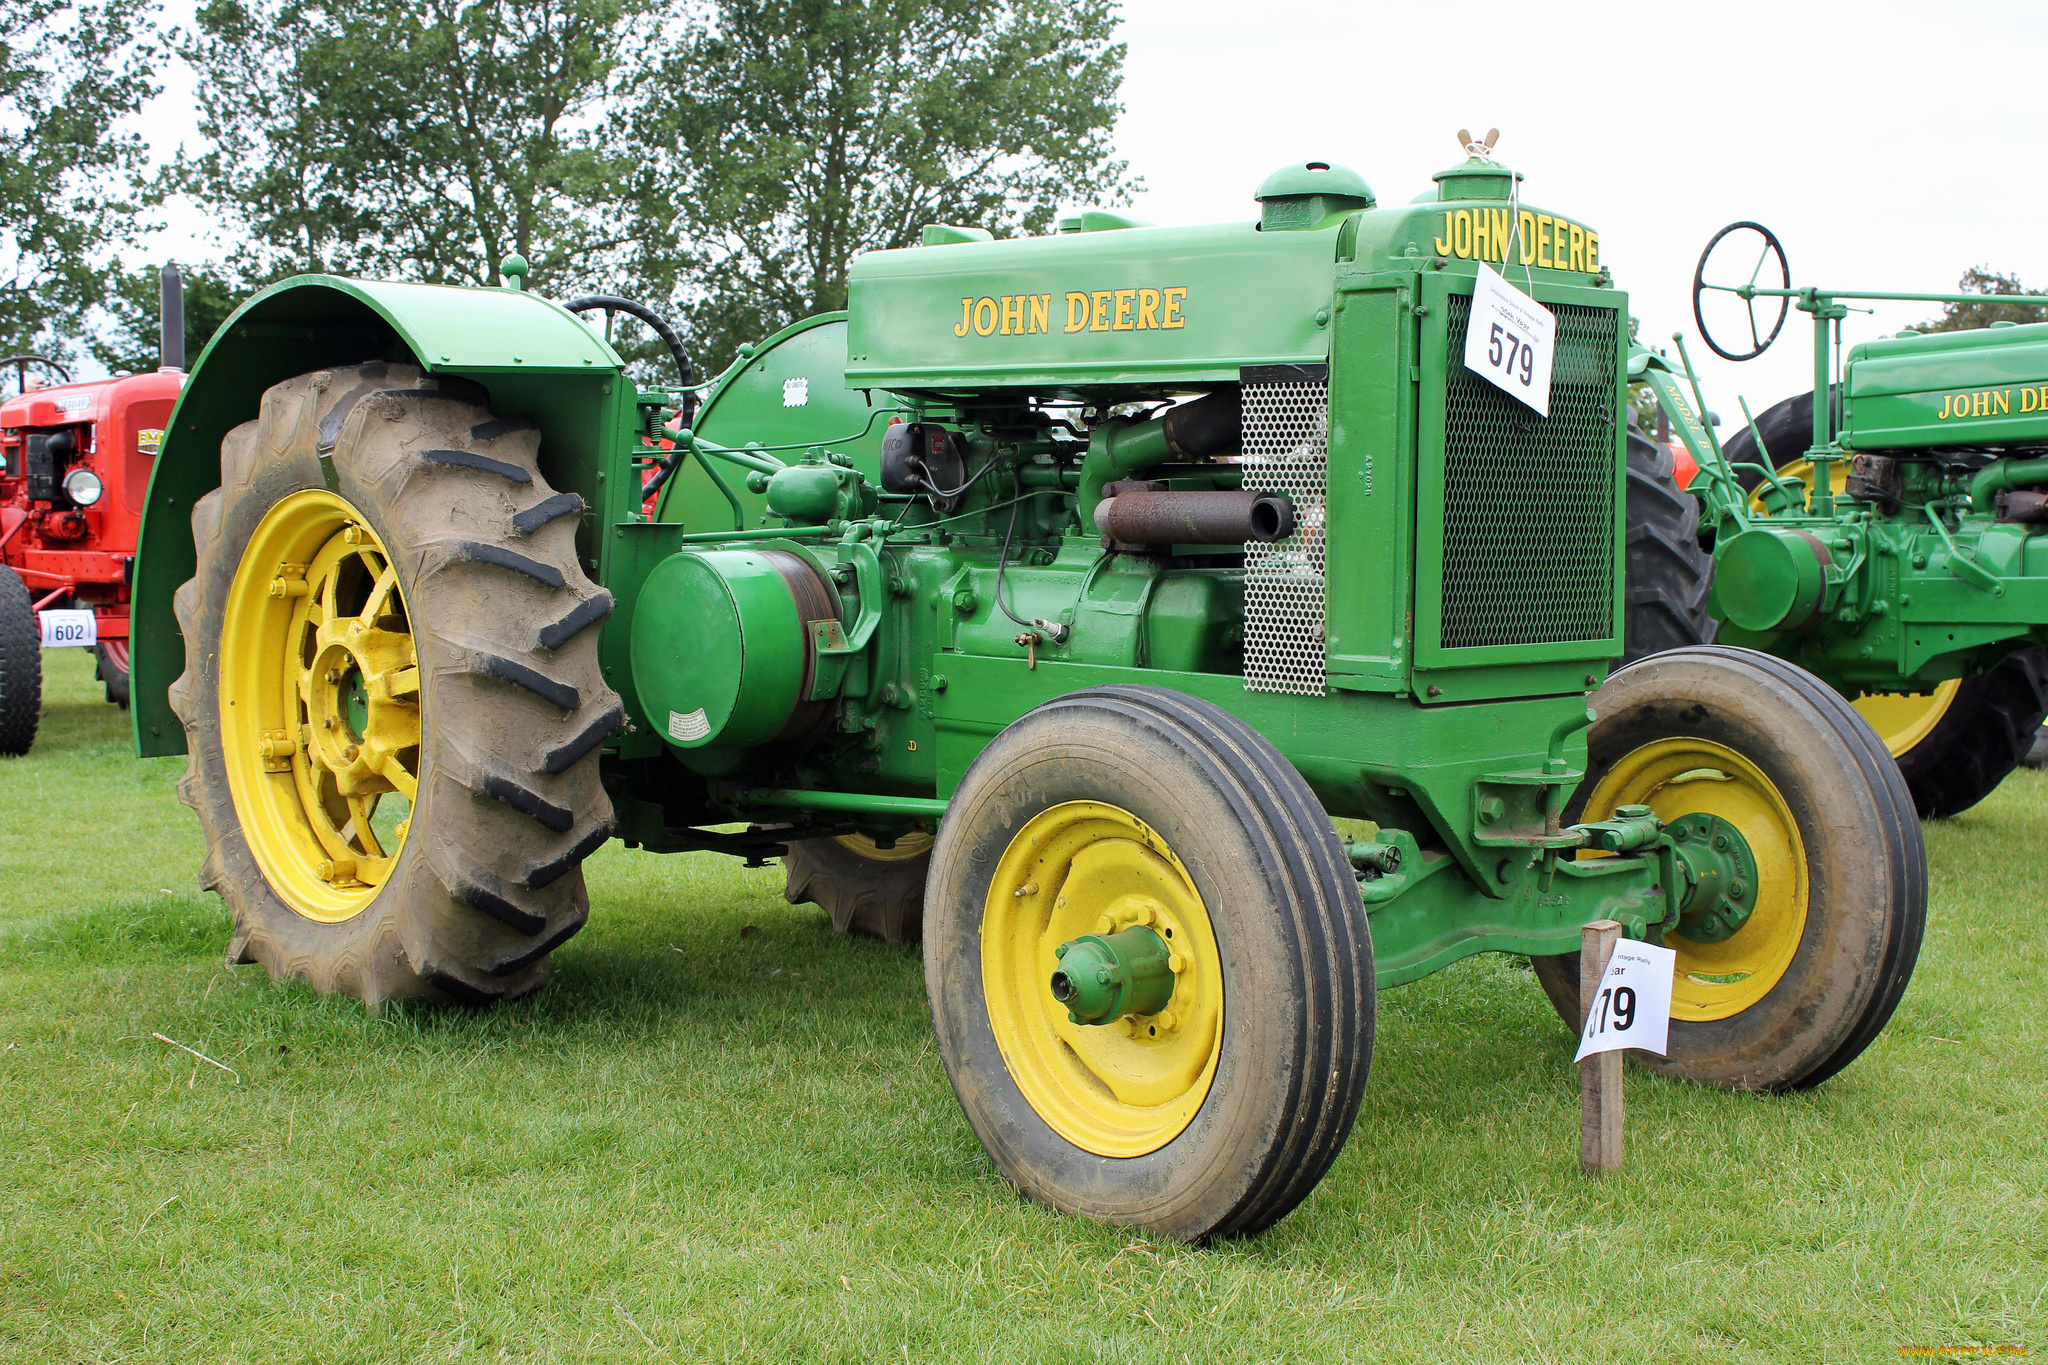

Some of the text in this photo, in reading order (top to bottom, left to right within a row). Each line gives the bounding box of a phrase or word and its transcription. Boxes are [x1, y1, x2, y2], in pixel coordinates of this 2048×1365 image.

[1434, 208, 1599, 274] JOHN DEERE
[954, 286, 1188, 338] JOHN DEERE
[1488, 322, 1533, 387] 579
[1665, 384, 1711, 449] MODEL B
[1938, 389, 2012, 420] JOHN
[55, 625, 84, 641] 602
[1637, 956, 1651, 966] Rally
